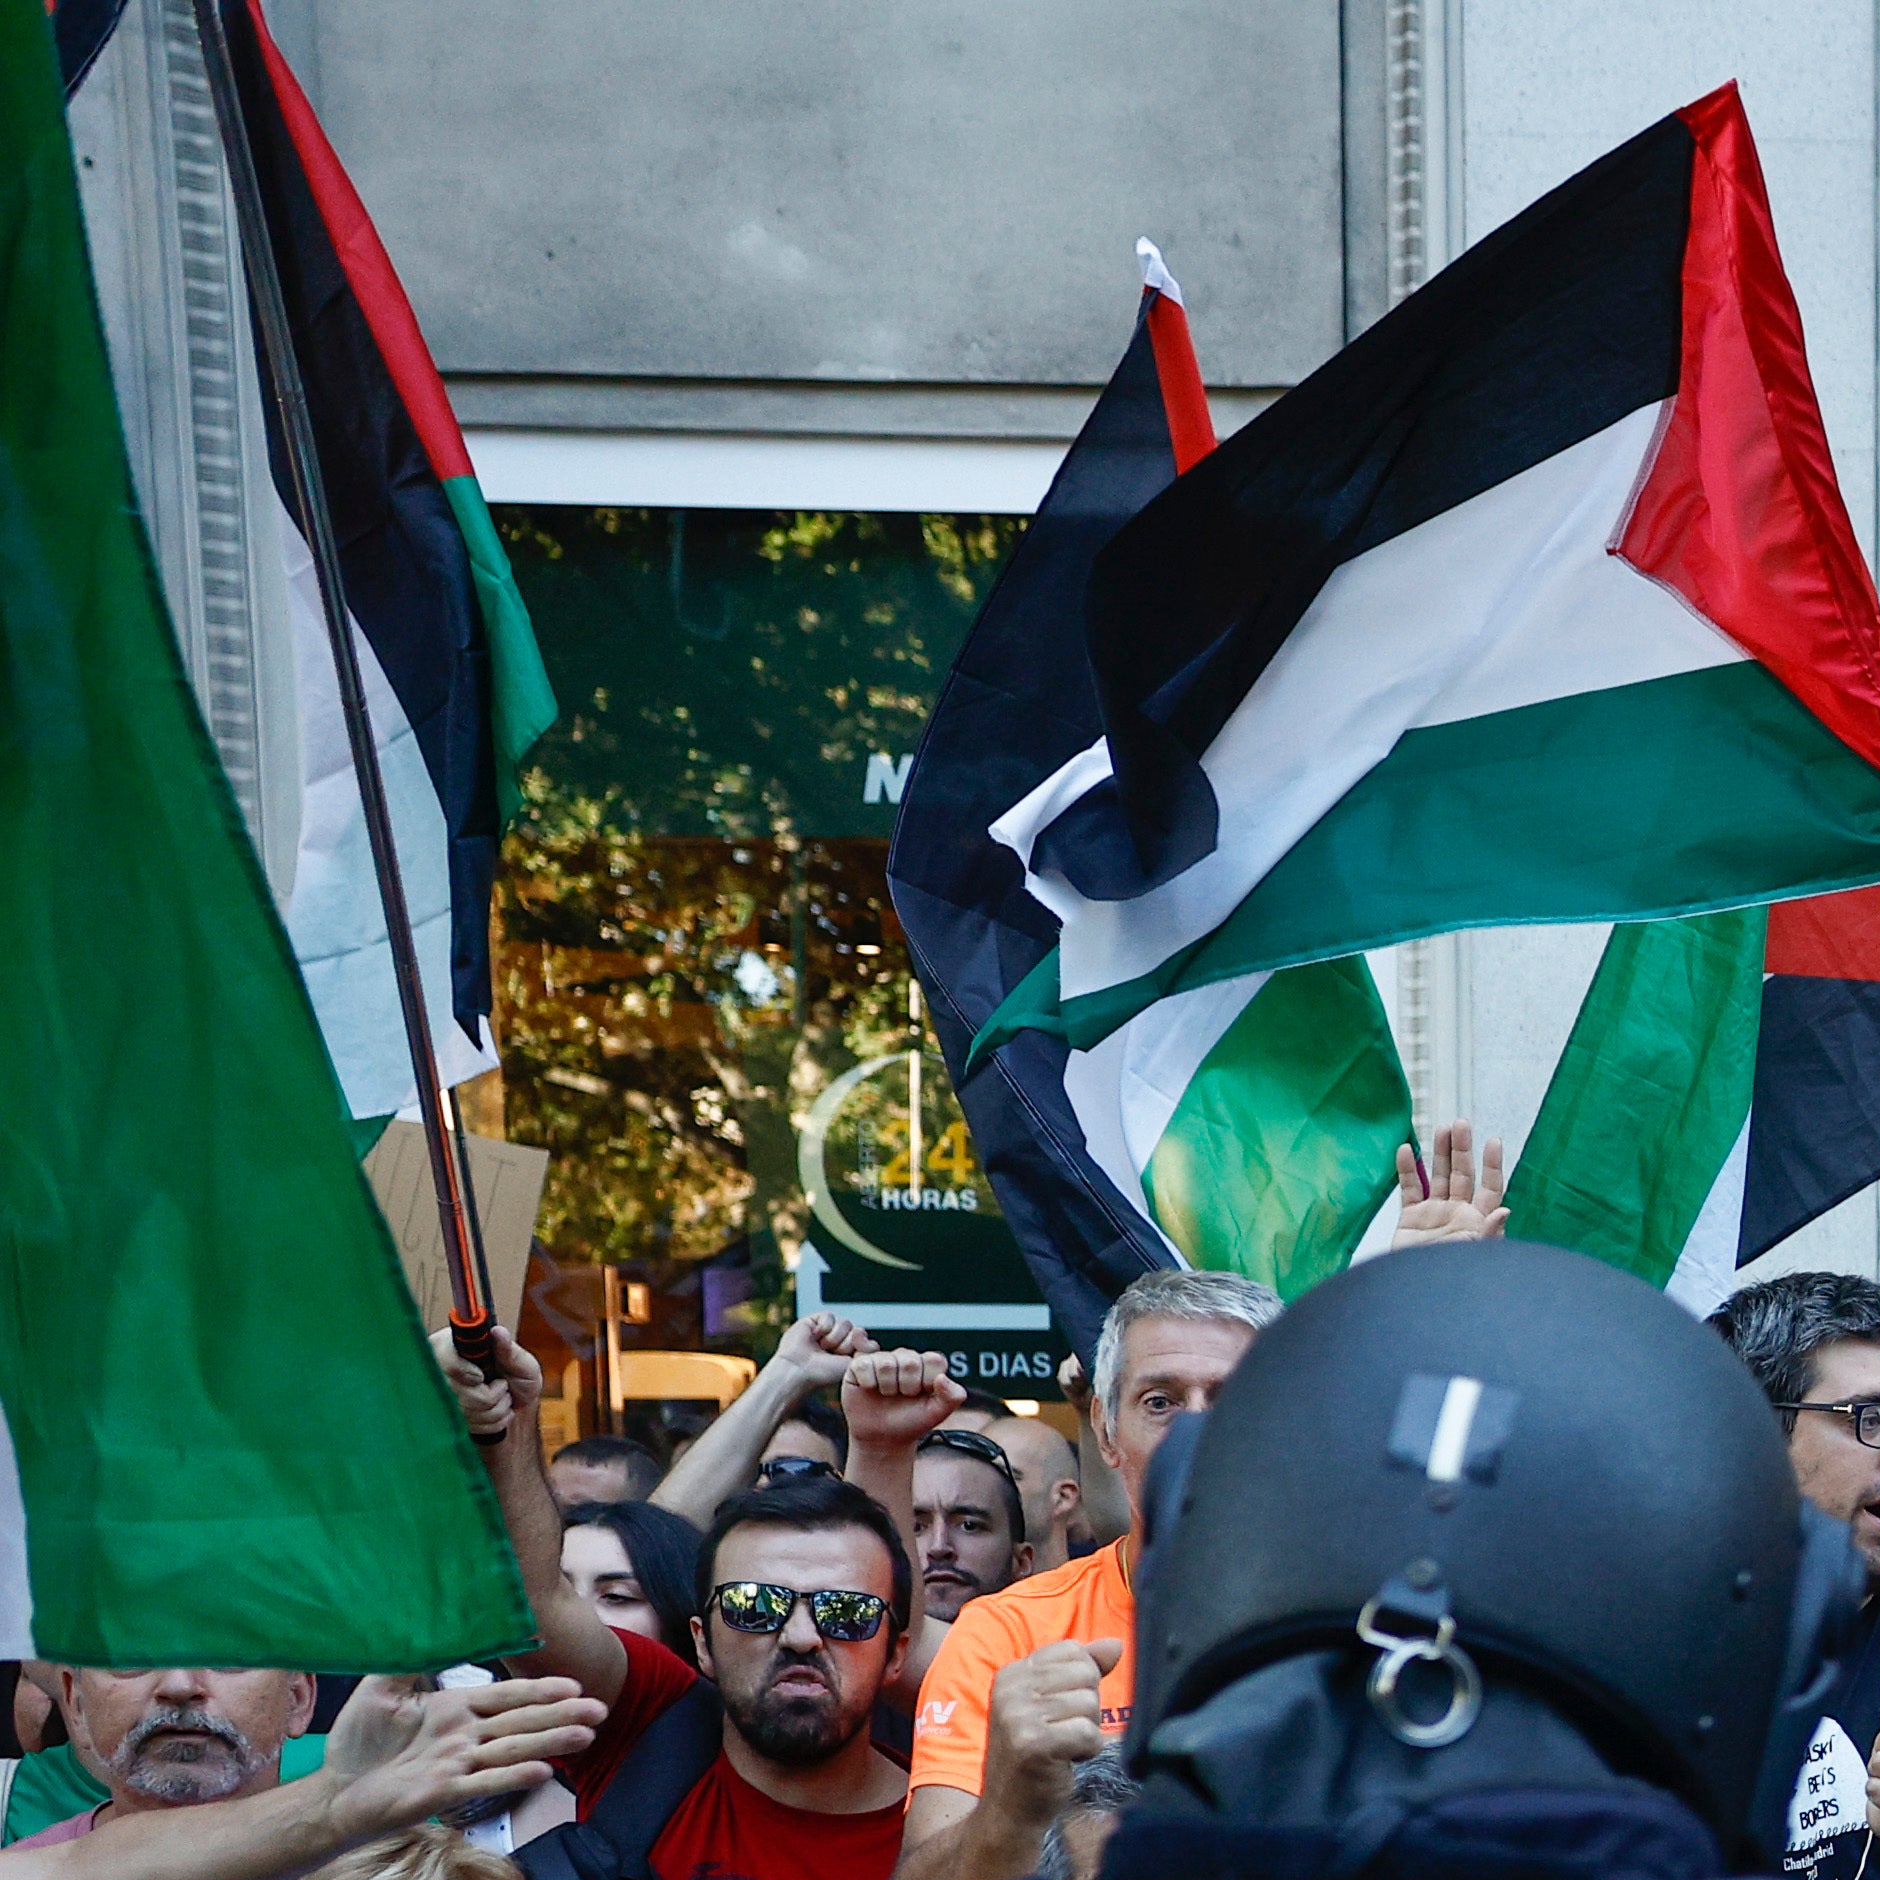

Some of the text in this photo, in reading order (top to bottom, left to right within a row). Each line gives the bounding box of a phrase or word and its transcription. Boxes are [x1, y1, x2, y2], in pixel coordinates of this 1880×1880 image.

[881, 1119, 975, 1184] 24
[881, 1187, 978, 1212] HORAS
[979, 1352, 1052, 1378] DIAS
